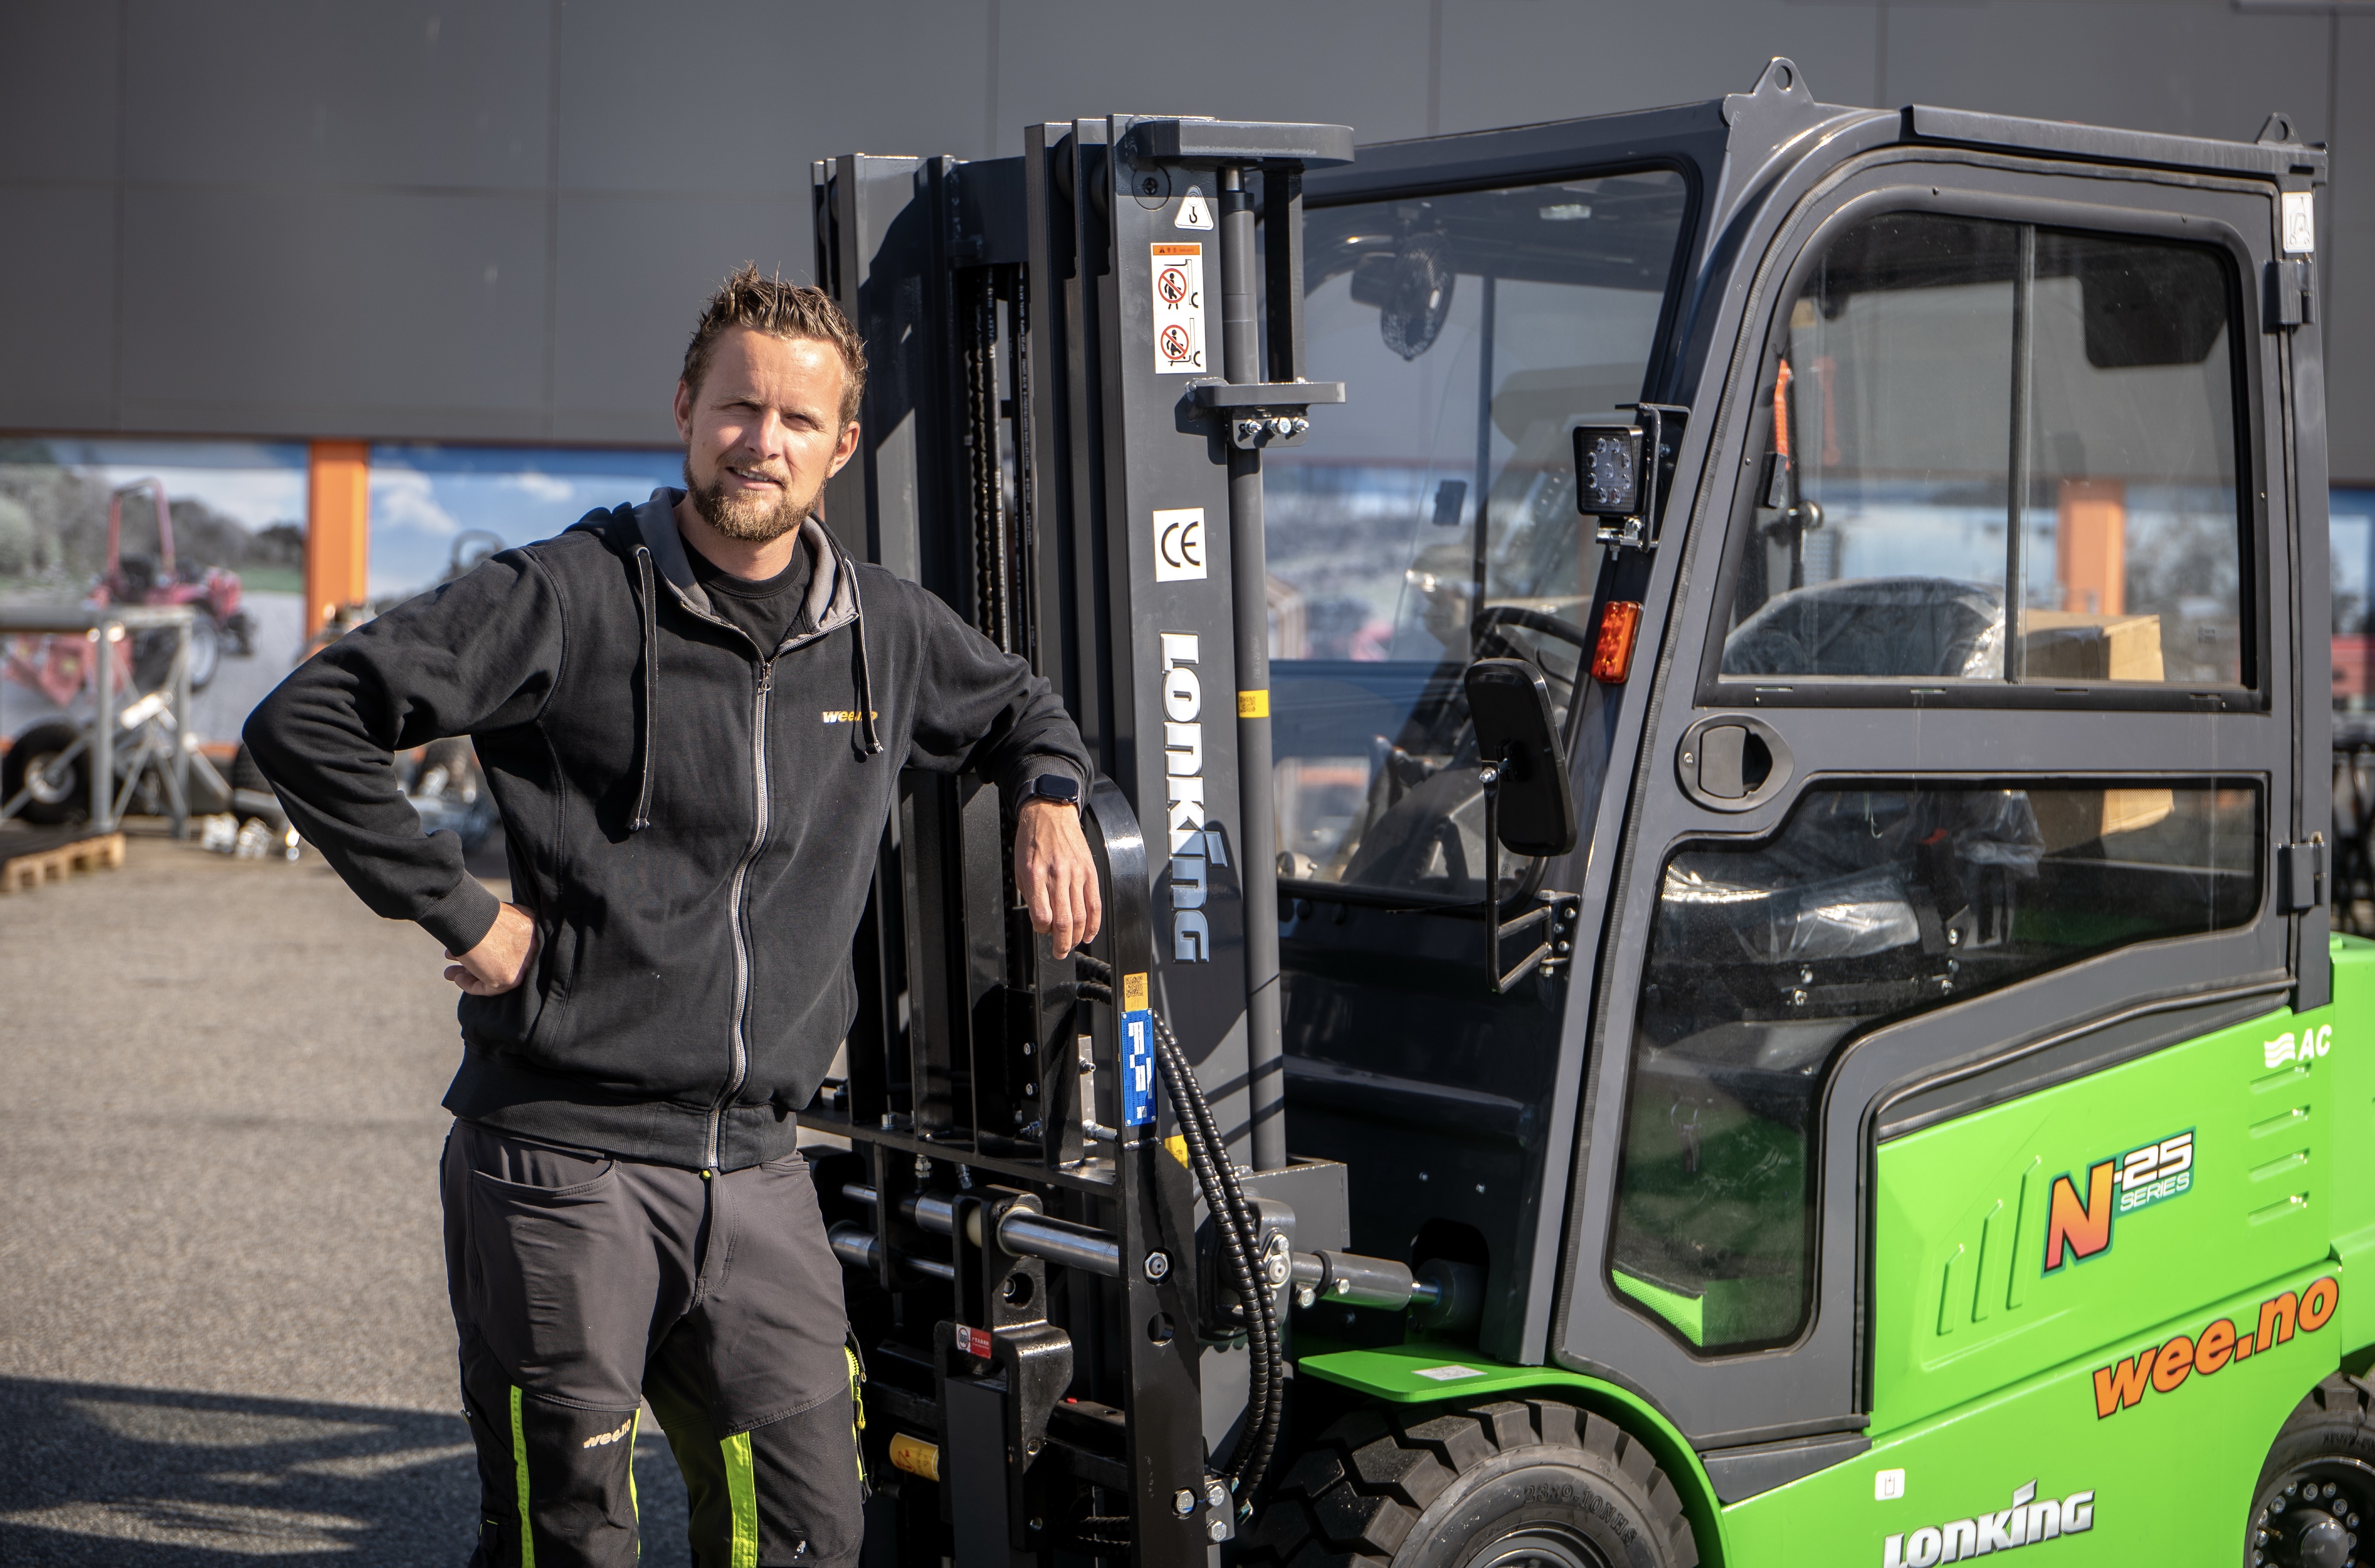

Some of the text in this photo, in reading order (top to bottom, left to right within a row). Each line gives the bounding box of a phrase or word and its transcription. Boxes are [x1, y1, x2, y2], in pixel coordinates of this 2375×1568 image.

[2298, 1023, 2332, 1062] AC
[2120, 1171, 2190, 1213] SERIES
[2093, 1276, 2340, 1420] wee.no
[583, 1418, 631, 1449] wee.no
